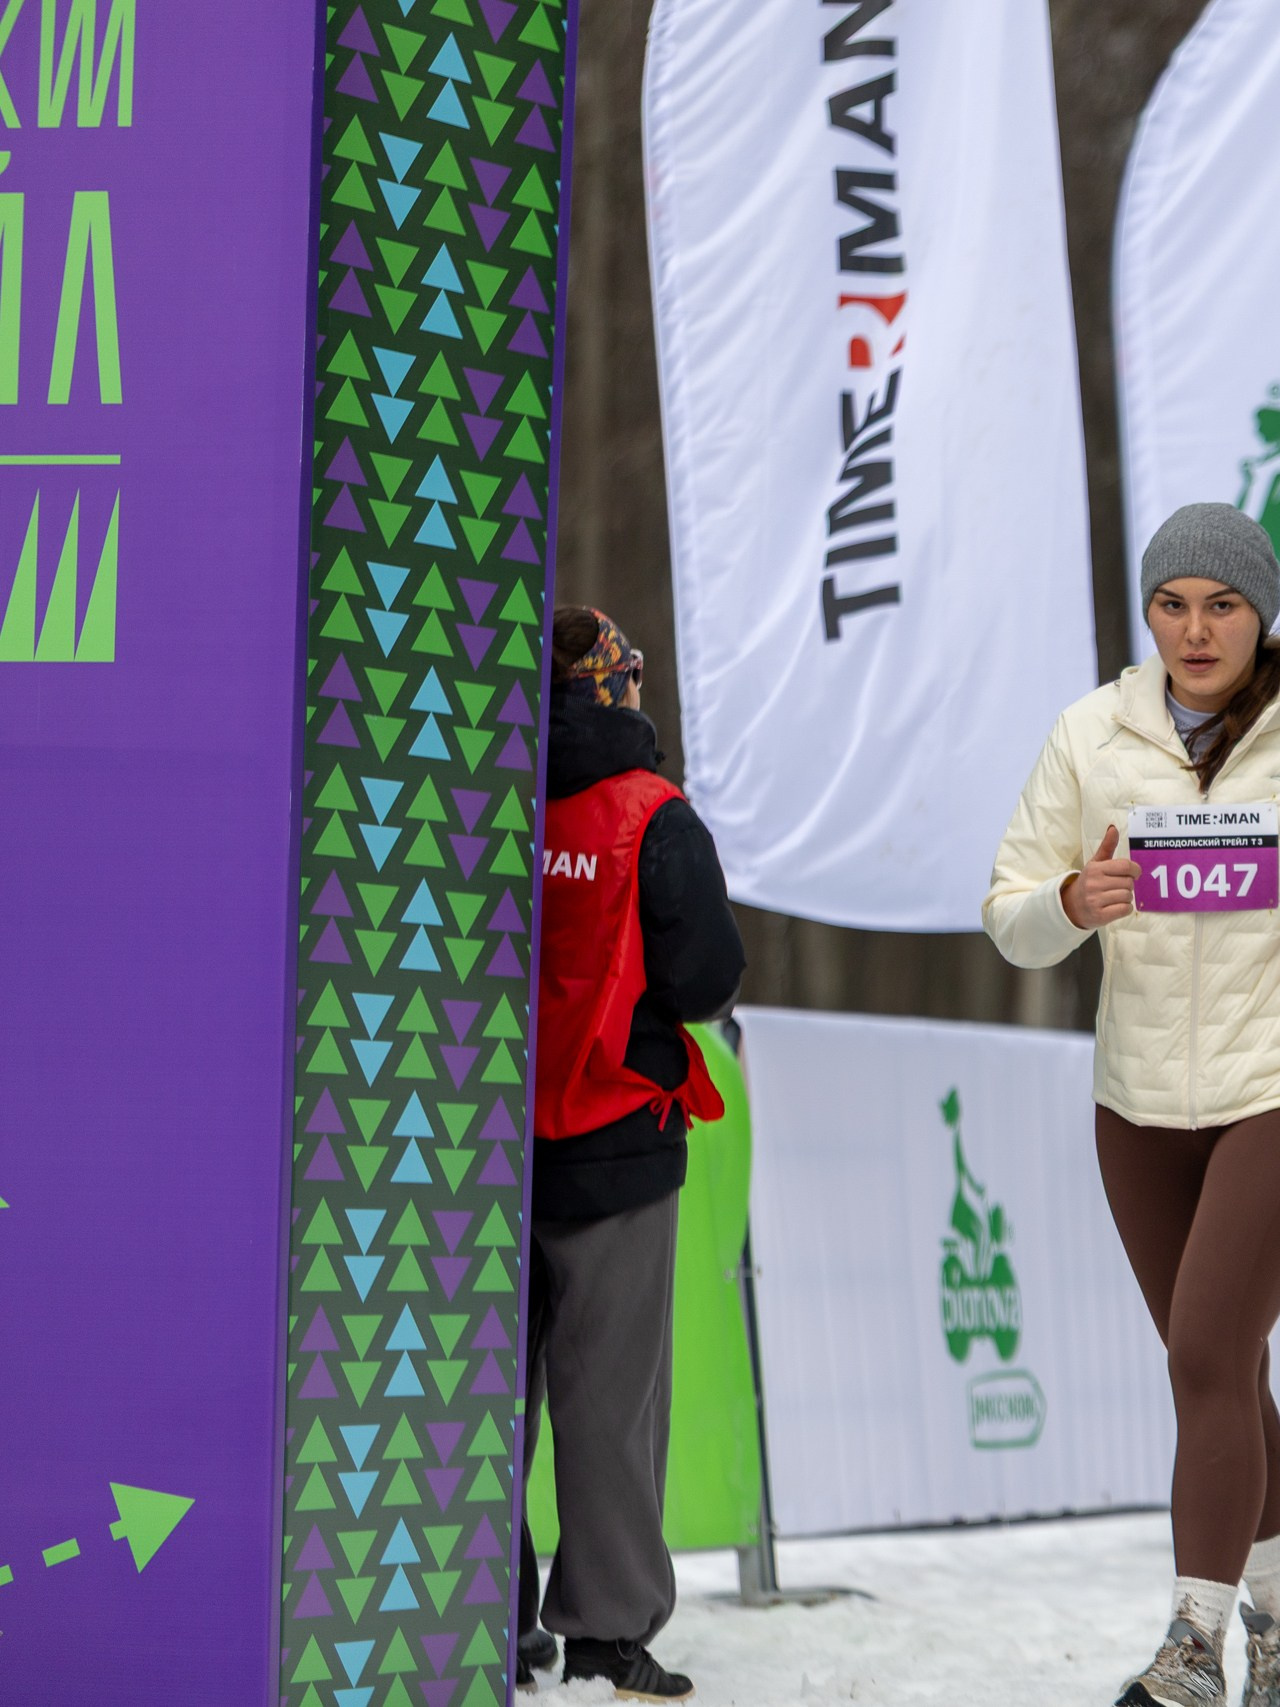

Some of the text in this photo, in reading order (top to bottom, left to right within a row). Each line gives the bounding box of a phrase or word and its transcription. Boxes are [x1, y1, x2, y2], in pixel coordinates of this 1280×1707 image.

[1144, 838, 1220, 848] ЗЕЛЕНОДОЛЬСКИЙ
[1221, 837, 1248, 847] ТРЕЙЛ
[1151, 863, 1258, 899] 1047
